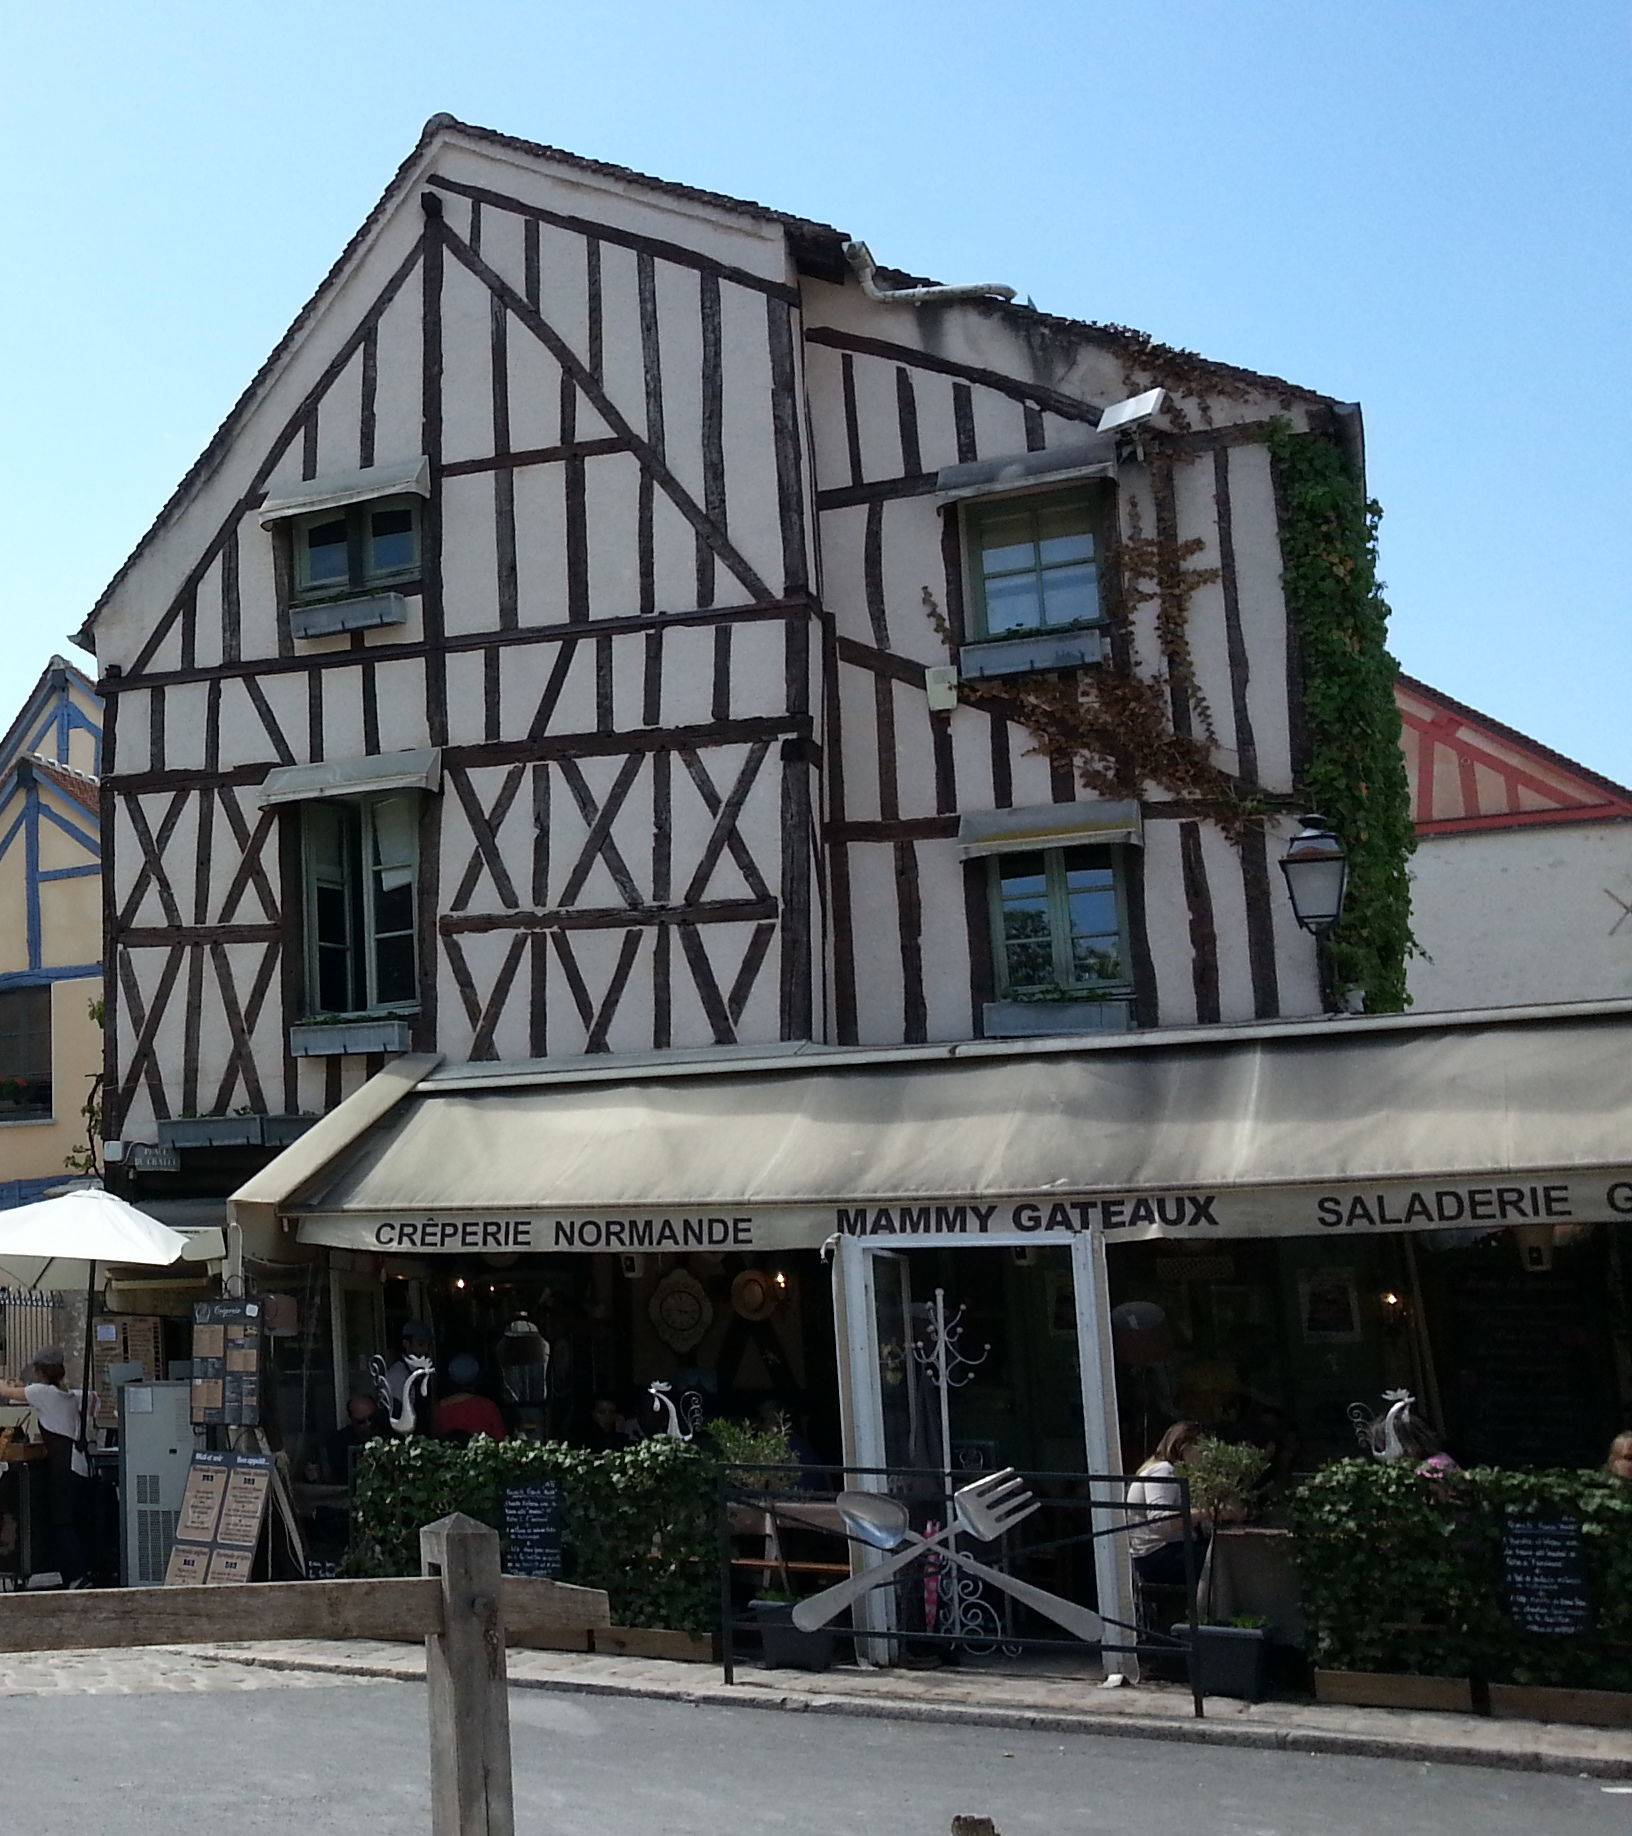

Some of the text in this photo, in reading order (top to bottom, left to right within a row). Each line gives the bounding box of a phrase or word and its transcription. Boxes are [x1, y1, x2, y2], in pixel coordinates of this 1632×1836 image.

[836, 1195, 1220, 1236] MAMMY GATEAUX
[1317, 1185, 1573, 1228] SALADERIE
[374, 1217, 753, 1248] CRÊPERIE NORMANDE
